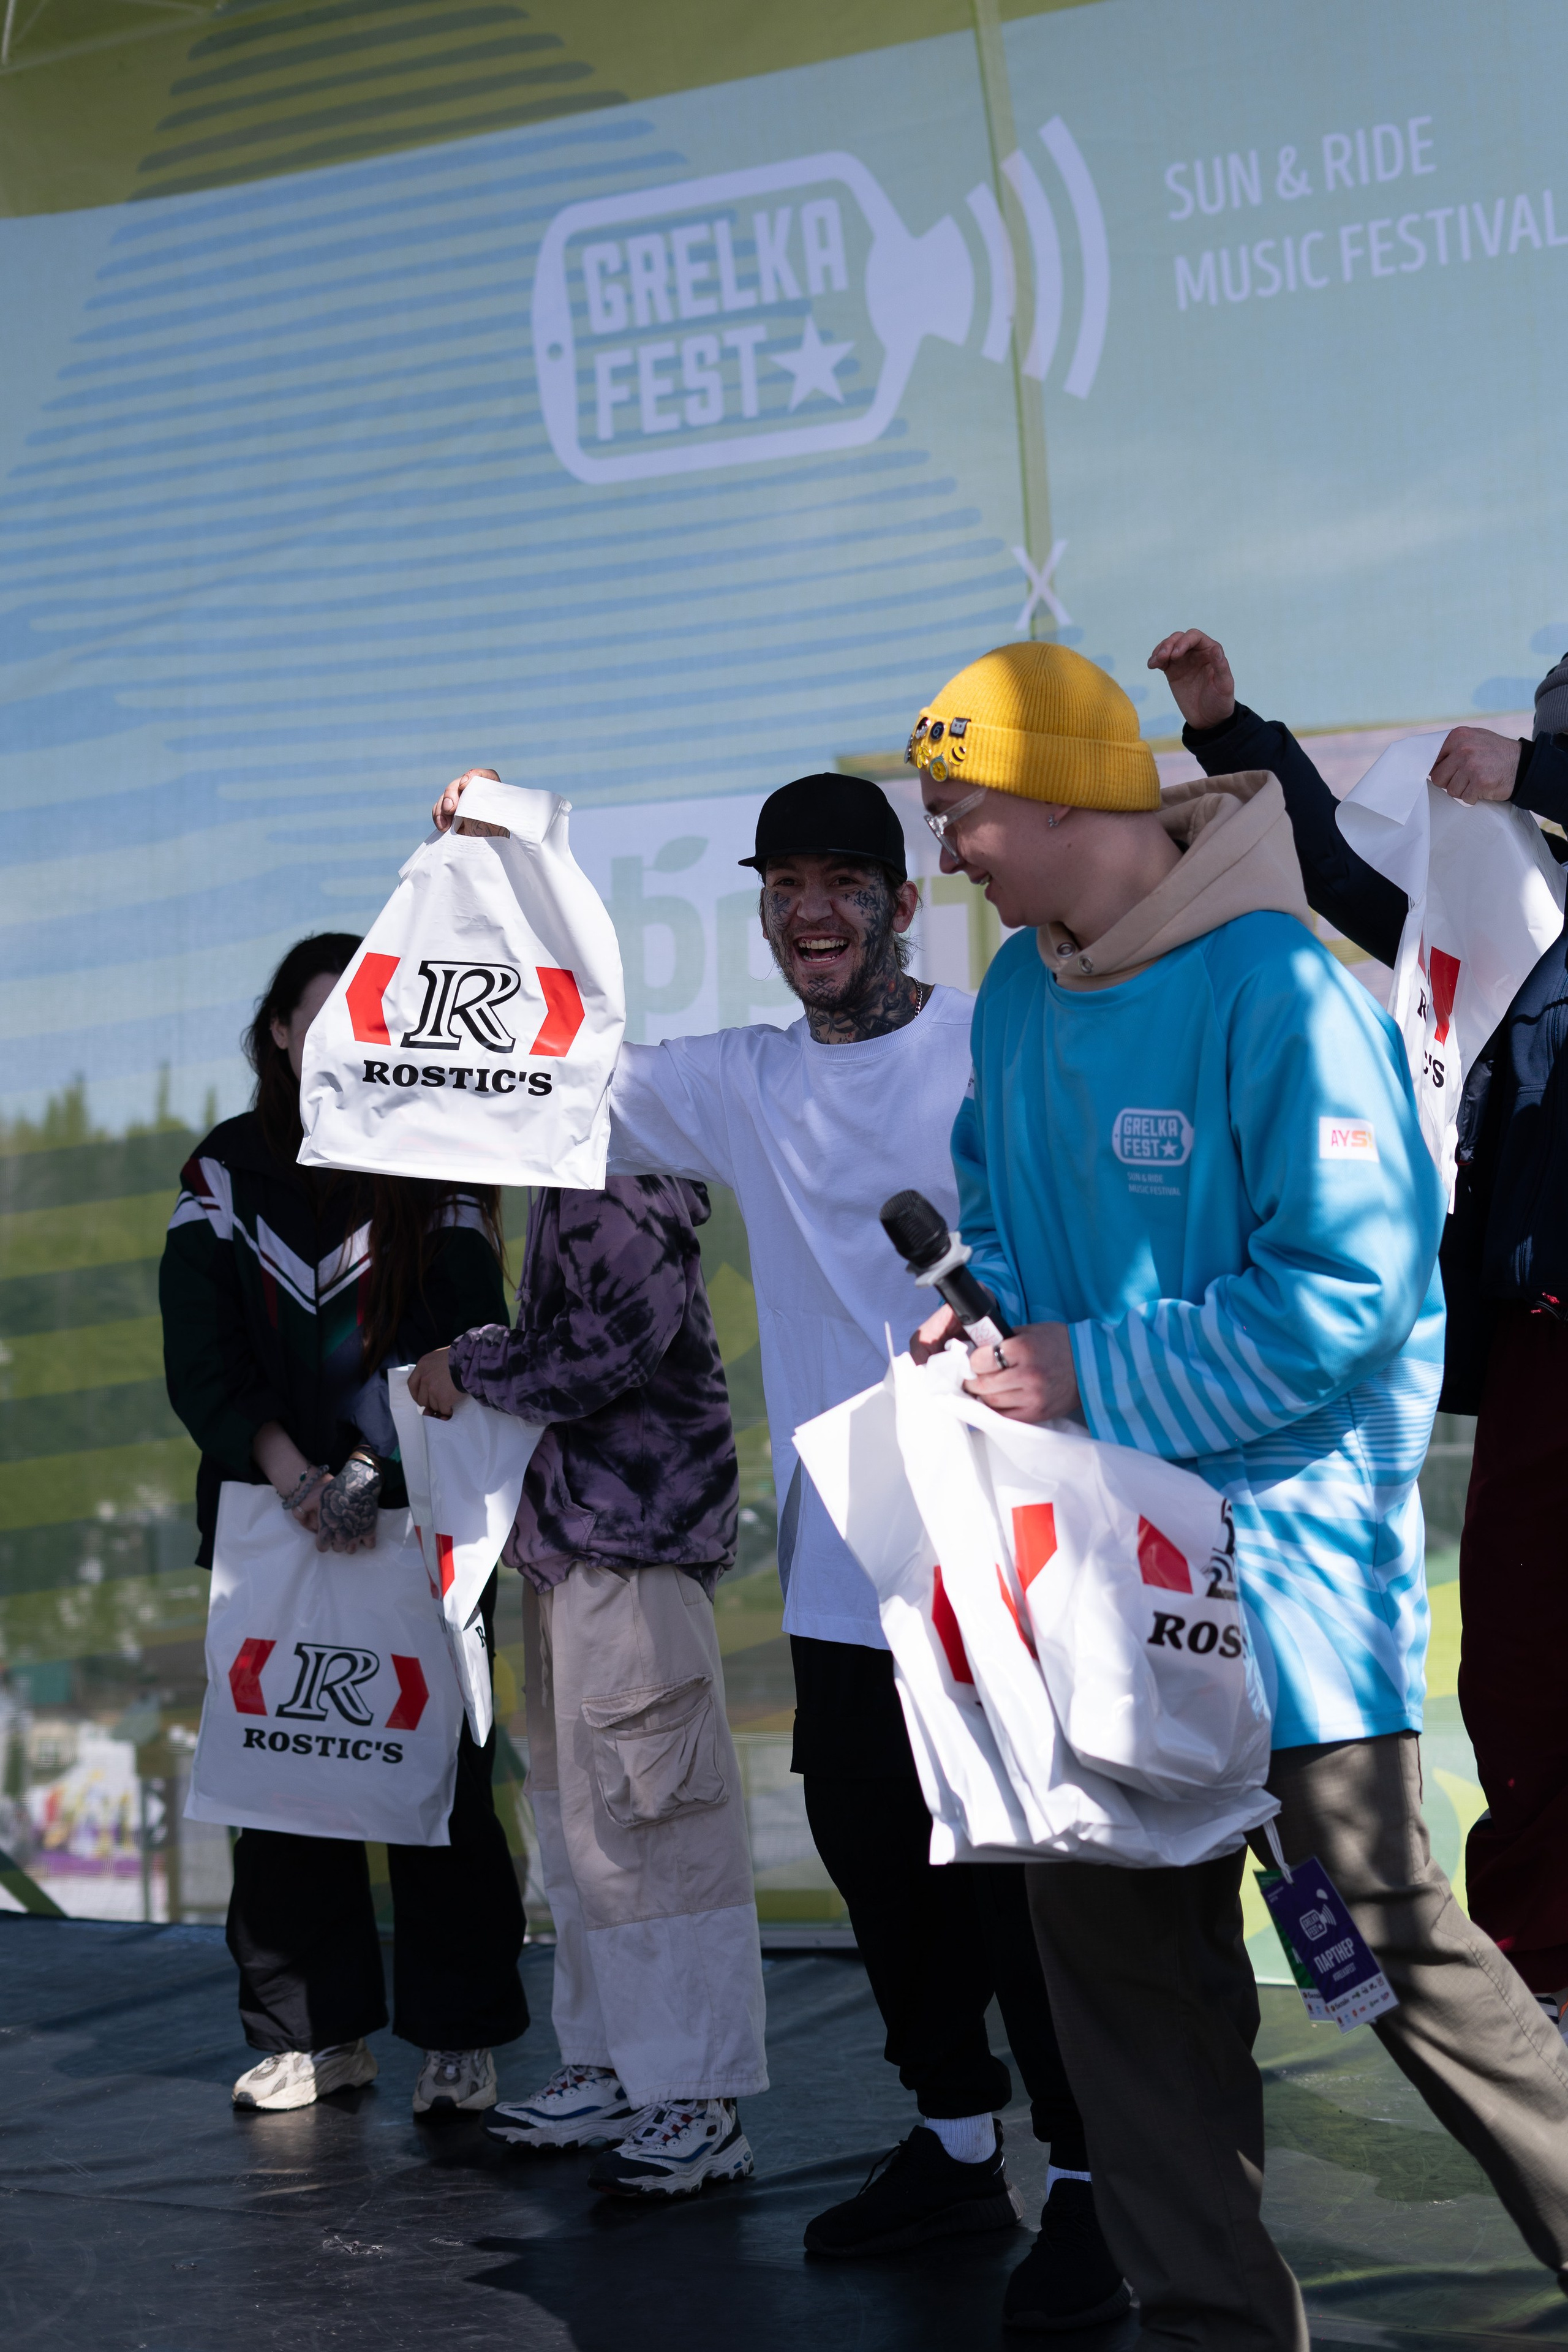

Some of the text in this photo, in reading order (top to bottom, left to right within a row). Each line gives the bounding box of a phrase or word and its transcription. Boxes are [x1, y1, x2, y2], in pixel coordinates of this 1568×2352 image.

[1165, 115, 1437, 221] SUN & RIDE
[582, 198, 850, 335] GRELKA
[1174, 188, 1568, 311] MUSIC FESTIVAL
[595, 325, 767, 441] FEST
[400, 960, 521, 1053] R
[362, 1059, 552, 1096] ROSTIC'S
[1123, 1117, 1178, 1137] GRELKA
[1123, 1138, 1160, 1158] FEST
[275, 1643, 380, 1726] R
[243, 1728, 404, 1764] ROSTIC'S
[1314, 1937, 1355, 1974] ПАРТНЕР
